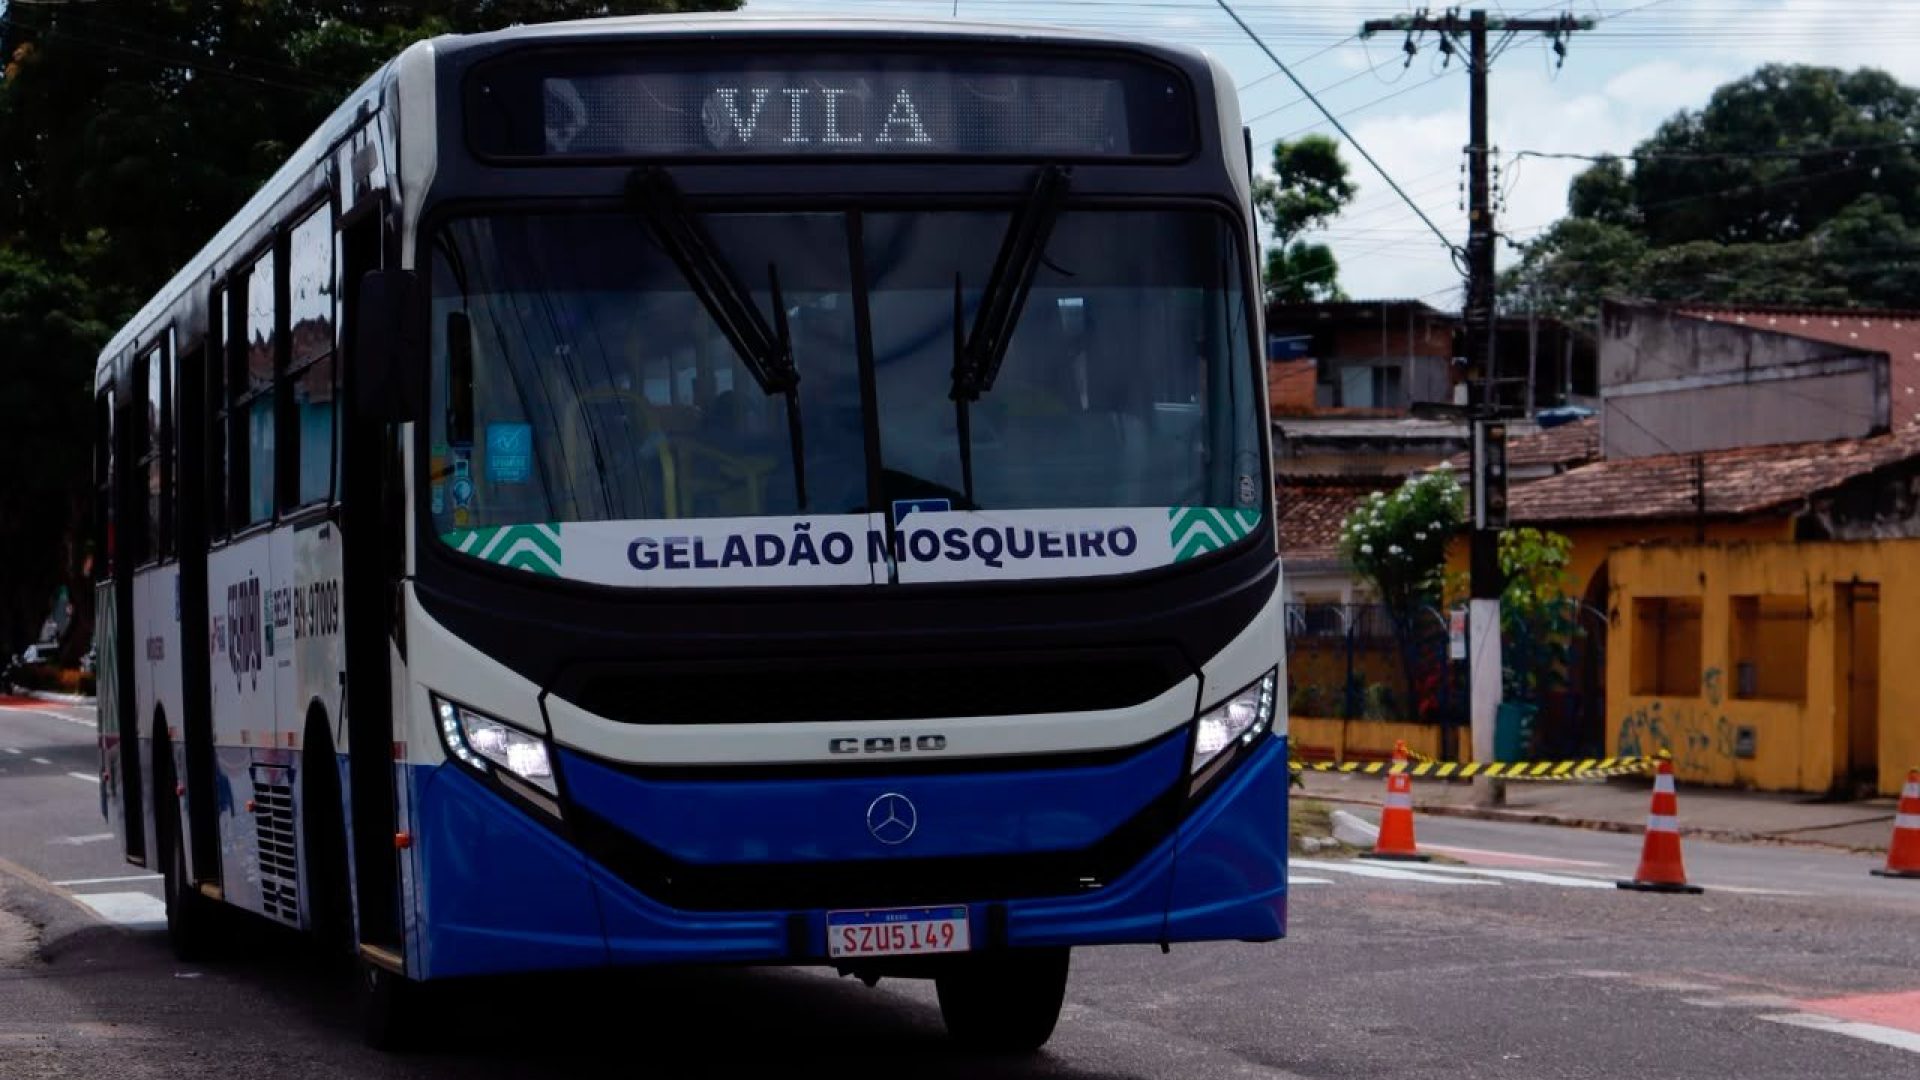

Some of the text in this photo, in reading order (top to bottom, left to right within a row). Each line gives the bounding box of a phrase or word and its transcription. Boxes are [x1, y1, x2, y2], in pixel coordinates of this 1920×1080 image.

[716, 88, 932, 142] VILA
[626, 522, 1137, 570] GELADÃO MOSQUEIRO
[828, 735, 947, 753] CAIO
